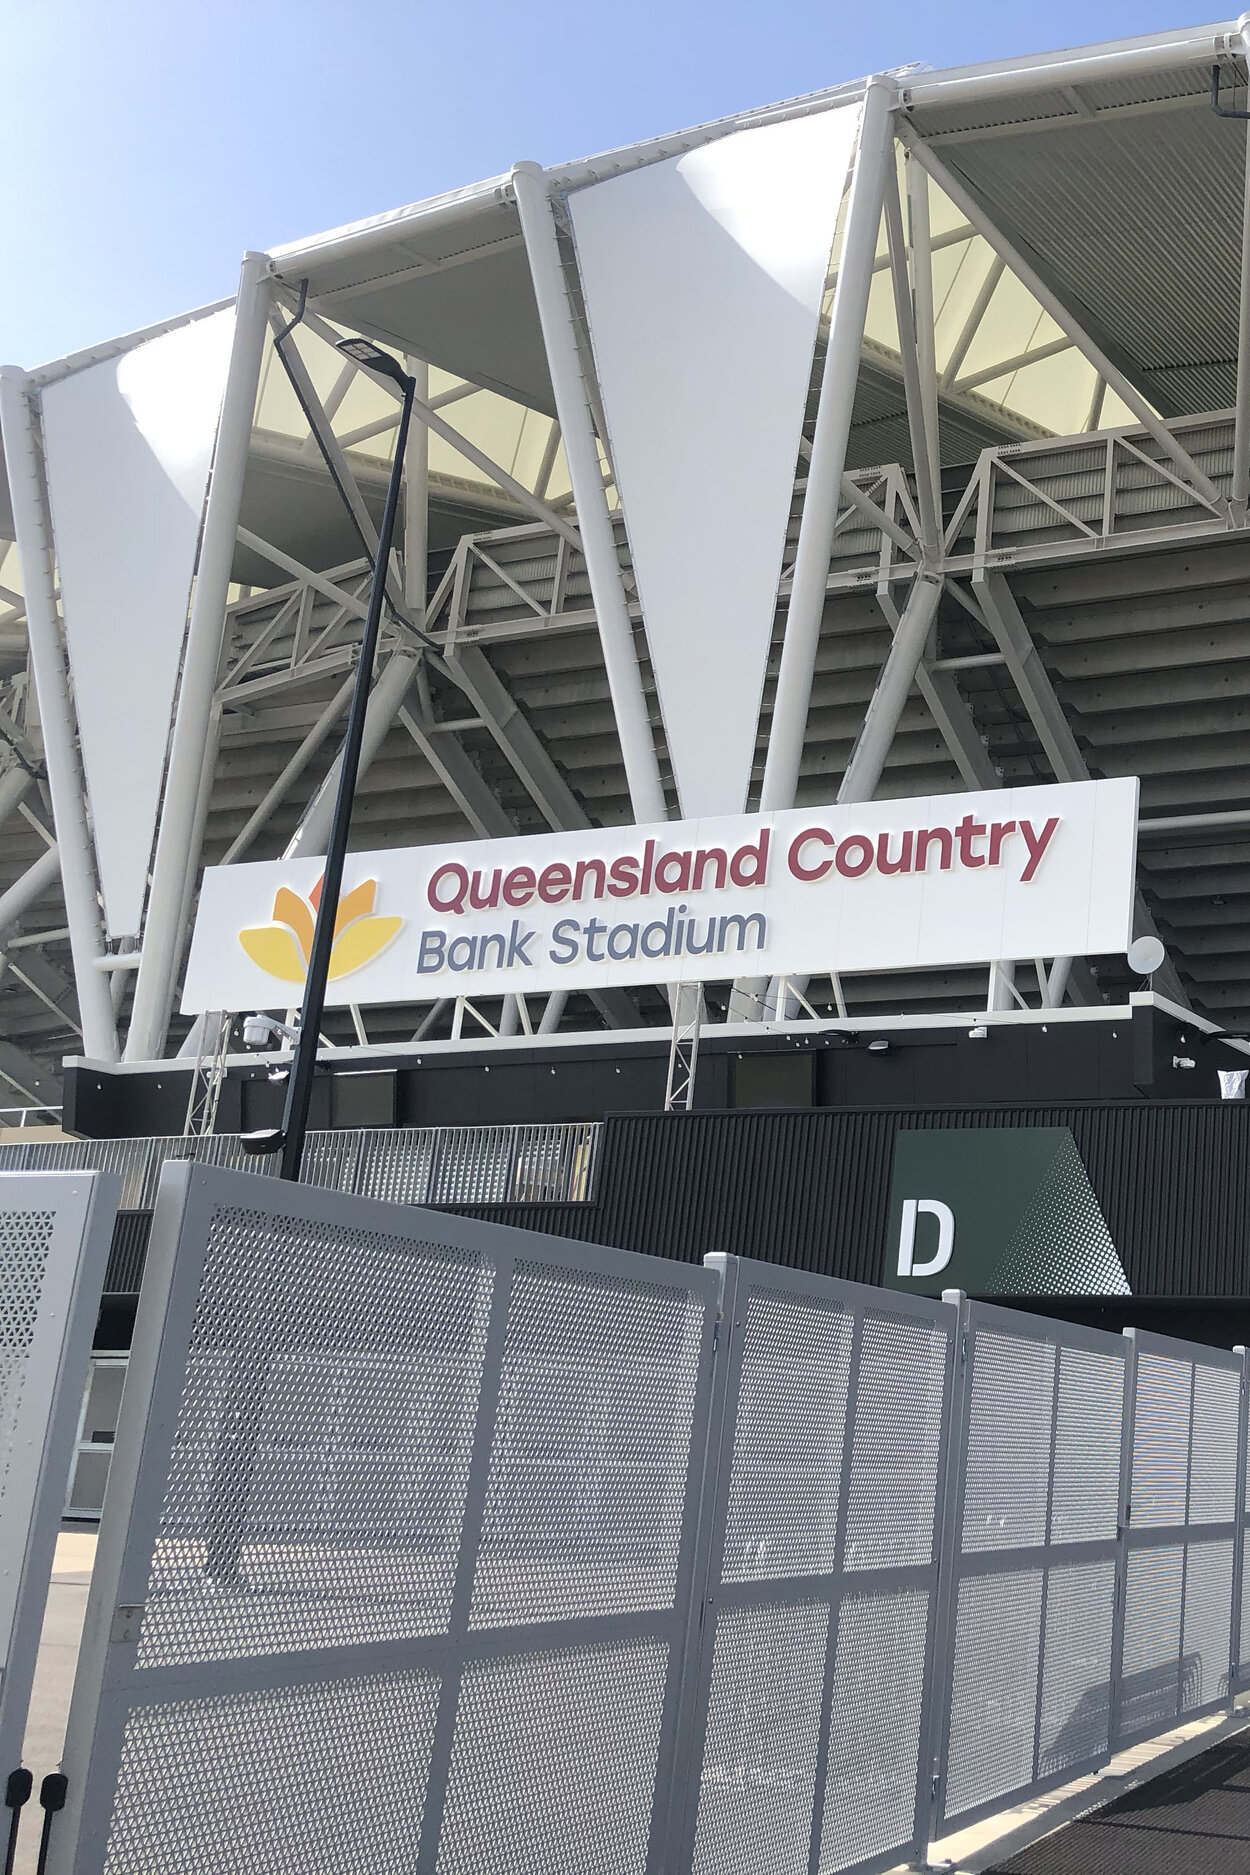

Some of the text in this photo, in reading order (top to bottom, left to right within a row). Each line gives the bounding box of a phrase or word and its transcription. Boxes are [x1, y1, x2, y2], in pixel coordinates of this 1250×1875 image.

[427, 814, 1060, 915] Queensland Country
[416, 904, 767, 975] Bank Stadium
[897, 1199, 955, 1276] D
